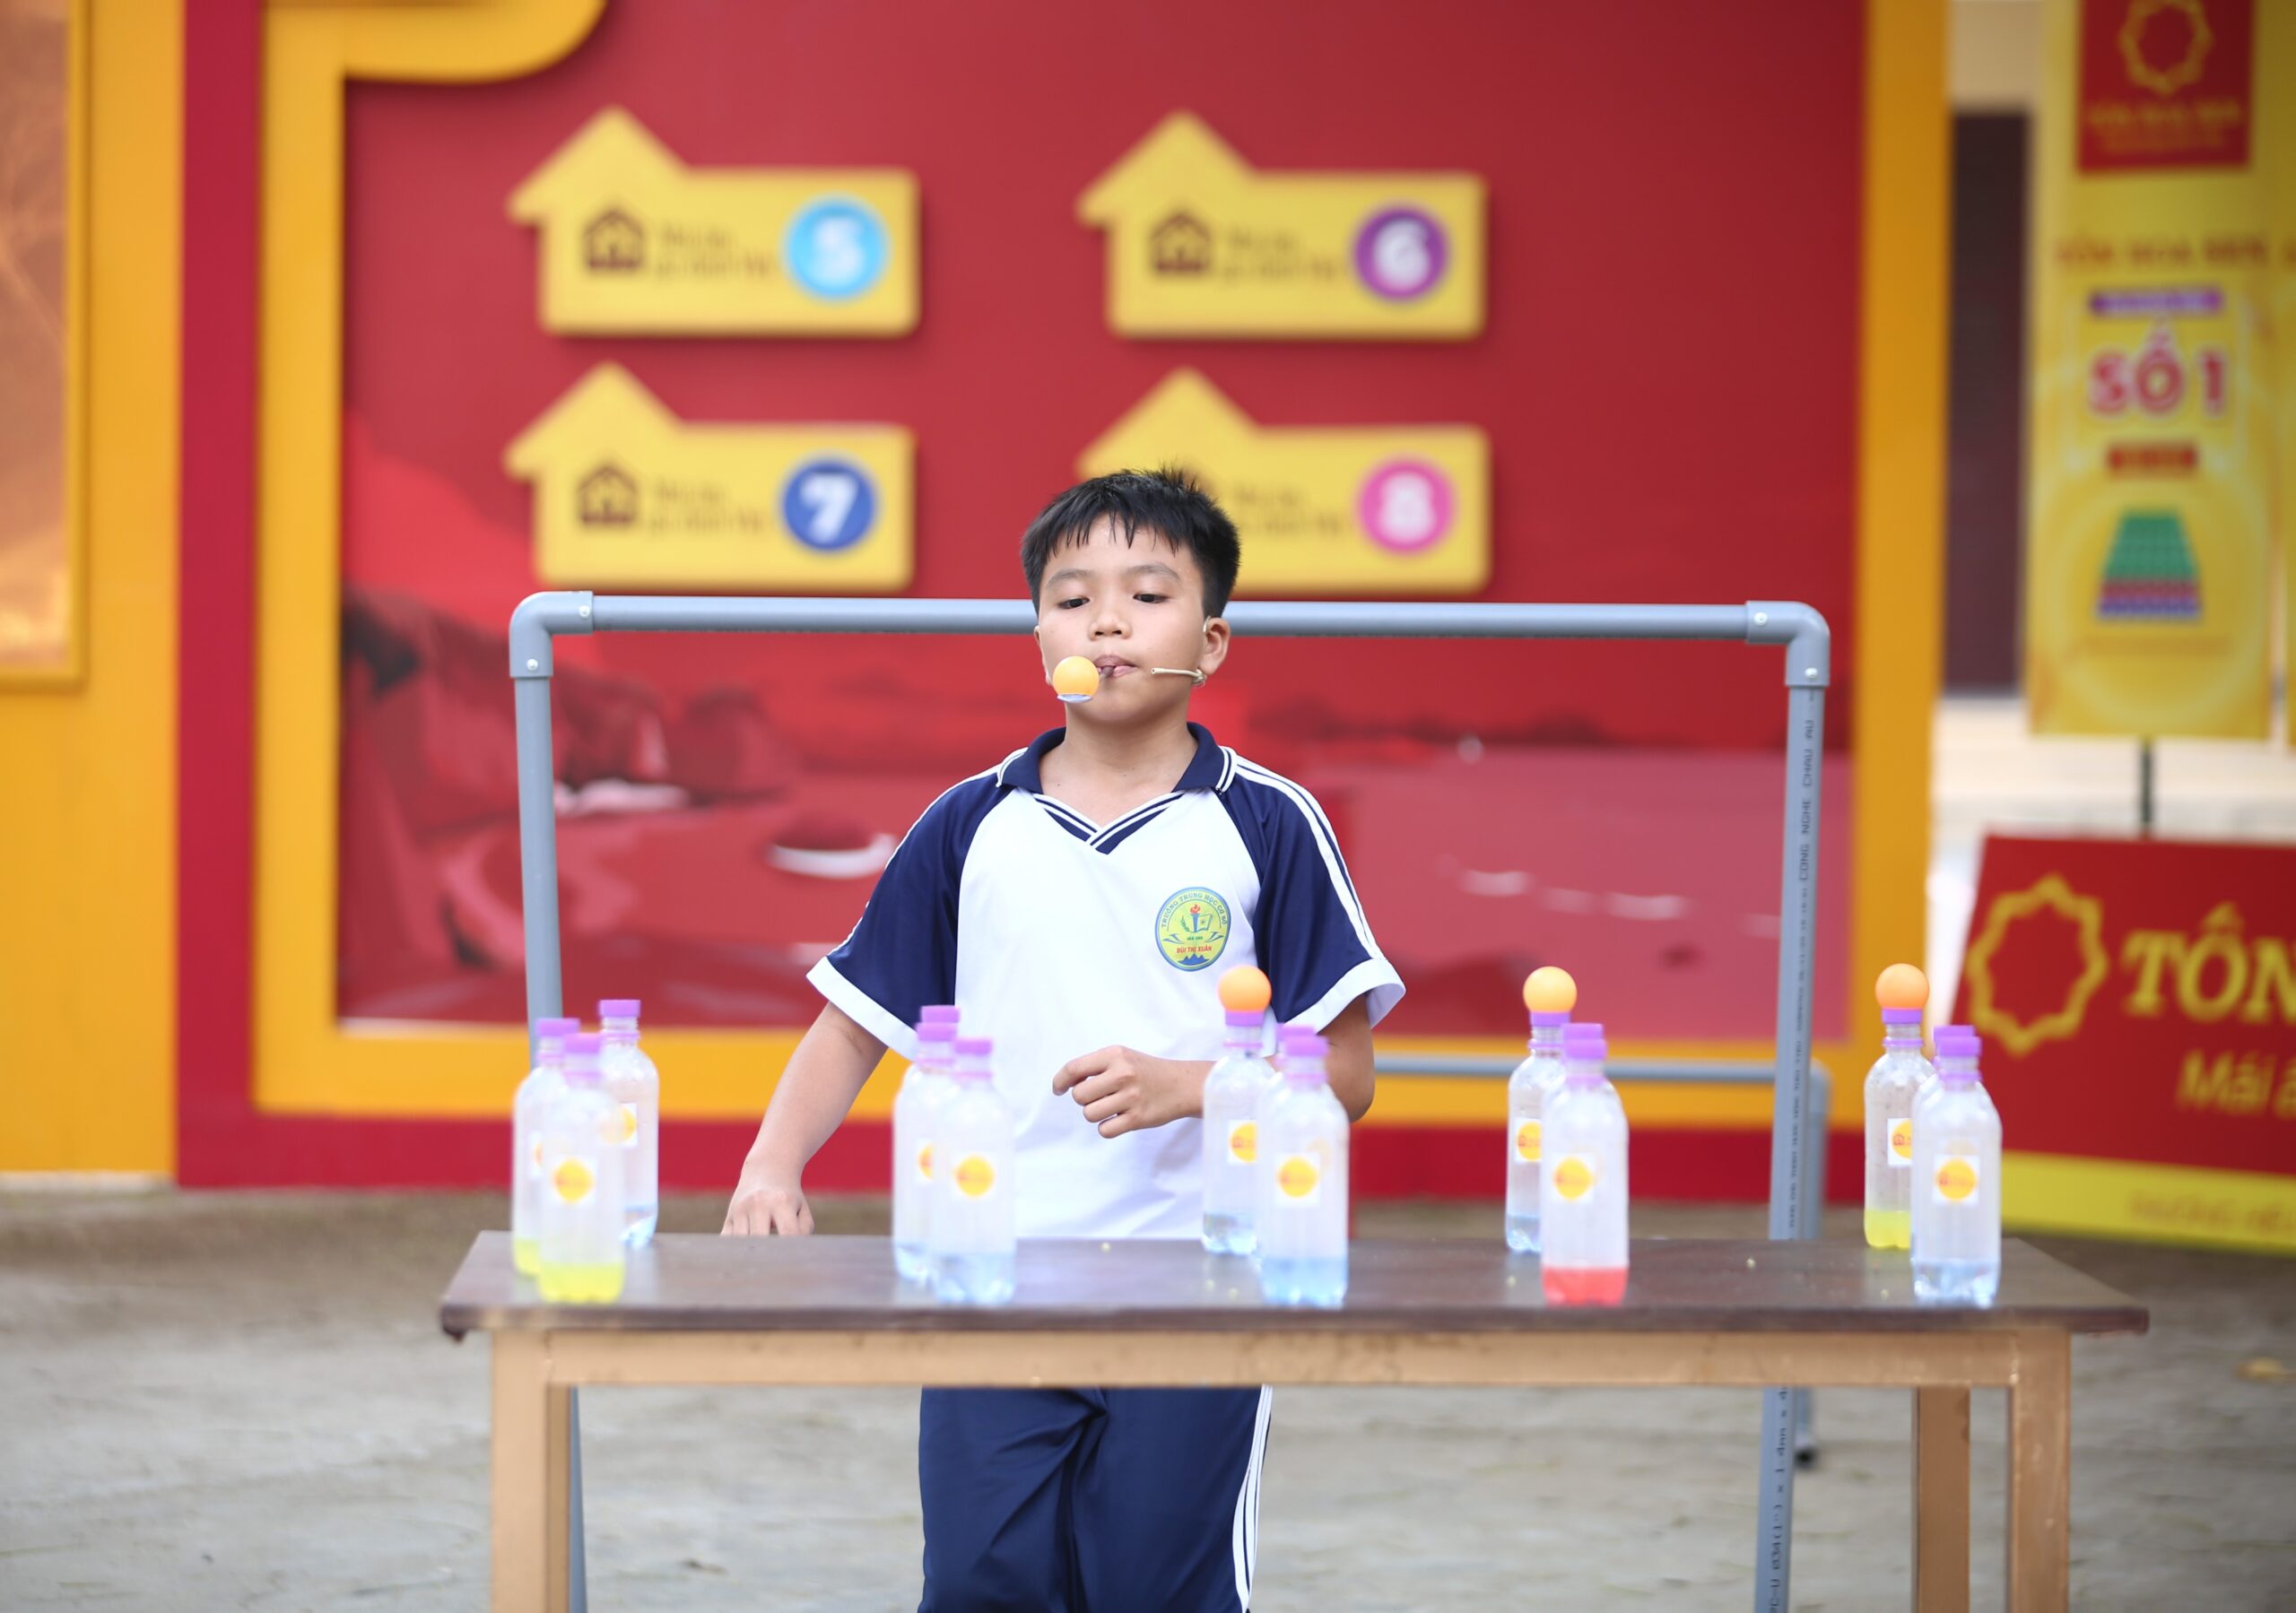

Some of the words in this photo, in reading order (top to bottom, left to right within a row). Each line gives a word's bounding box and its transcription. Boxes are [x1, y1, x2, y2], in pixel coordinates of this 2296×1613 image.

[811, 215, 866, 288] 5
[1373, 215, 1431, 288] 6
[2091, 324, 2183, 416] SỐ
[2201, 349, 2222, 416] 1
[798, 473, 858, 544] 7
[1377, 473, 1436, 544] 8
[1805, 720, 1814, 740] AU
[1803, 749, 1813, 787] CHAU
[1801, 797, 1812, 835] NGHE
[1799, 844, 1809, 881] CONG
[1178, 892, 1203, 902] TRUNG
[1197, 944, 1213, 953] XUÂN
[2120, 899, 2296, 1028] TÔN
